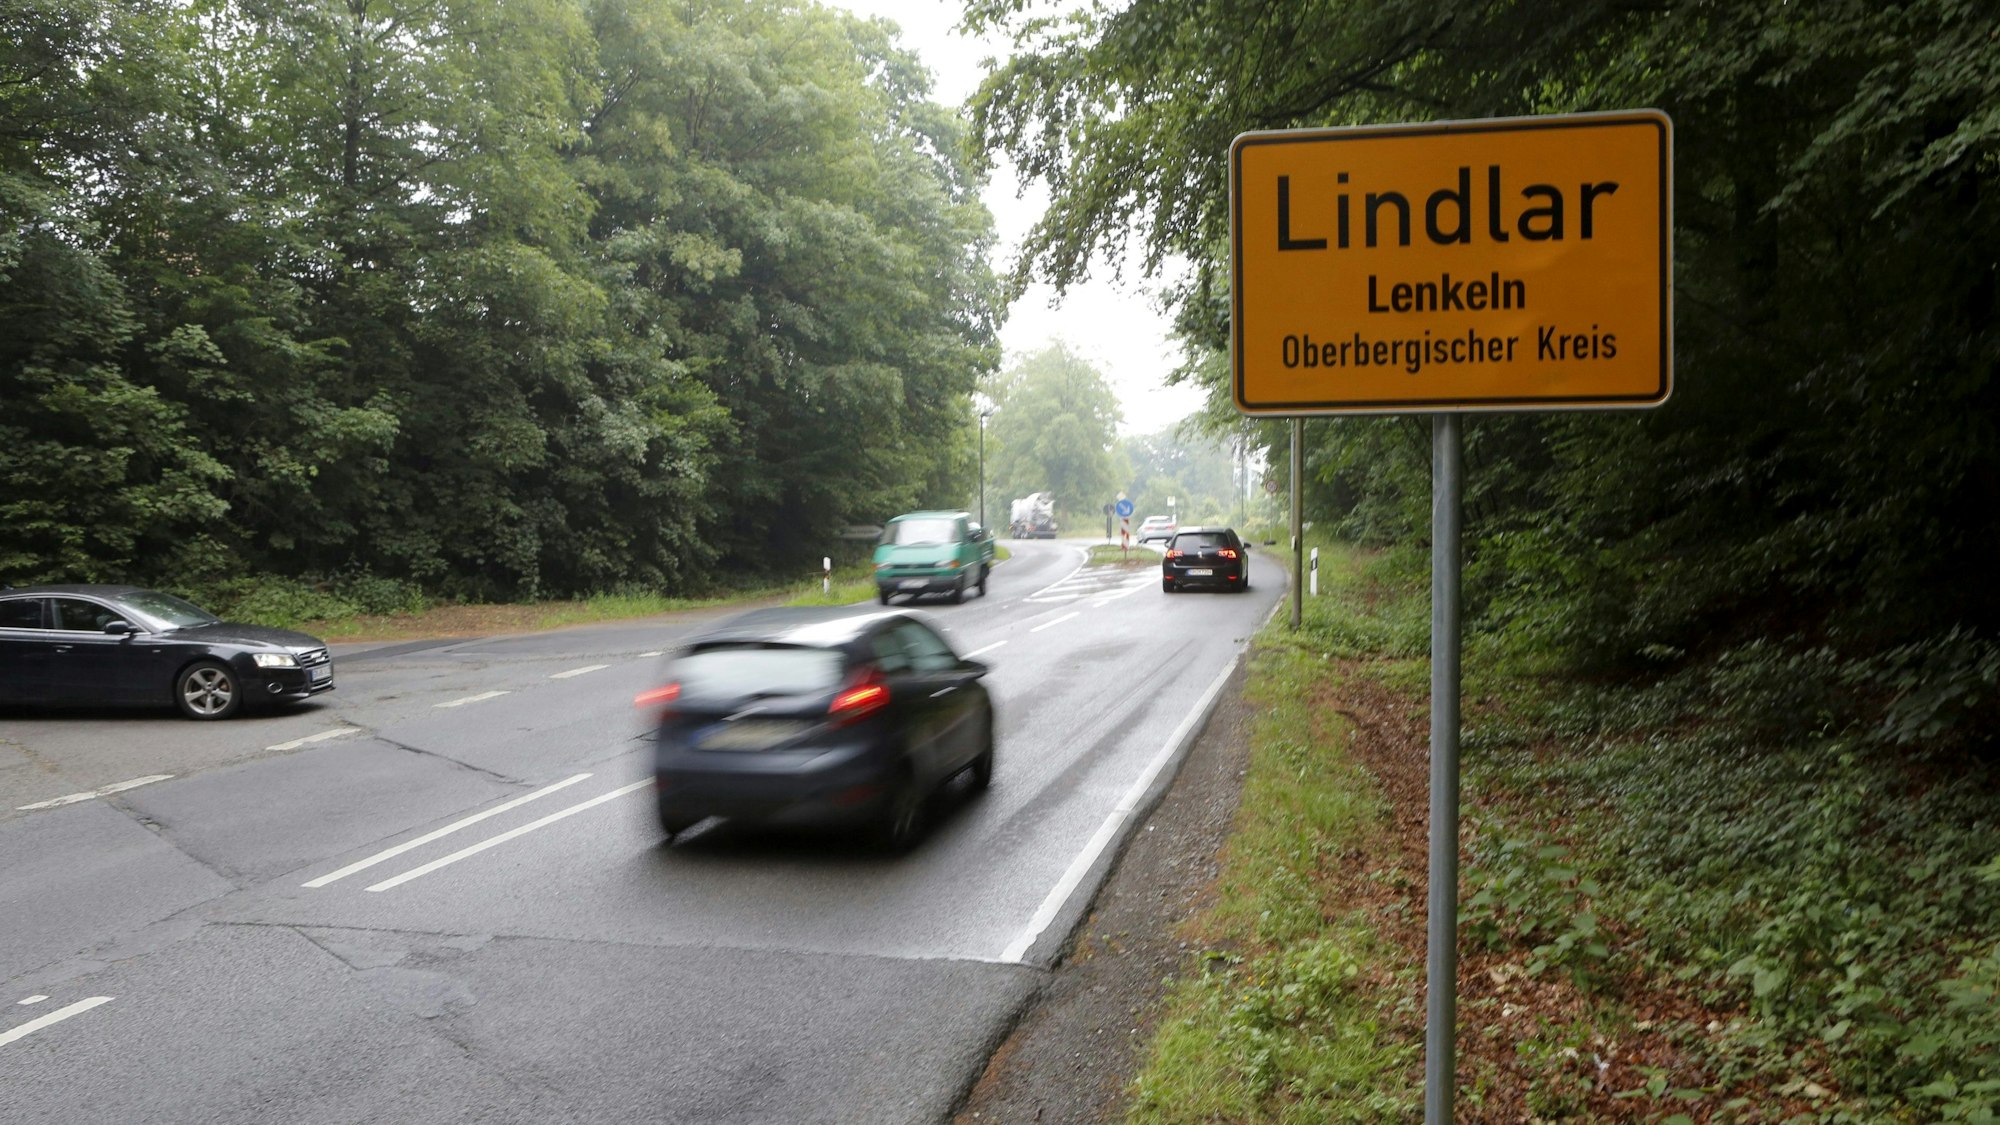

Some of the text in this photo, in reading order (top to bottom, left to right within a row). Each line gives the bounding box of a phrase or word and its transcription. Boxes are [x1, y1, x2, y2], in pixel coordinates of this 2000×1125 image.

[1277, 165, 1619, 251] Lindlar
[1368, 272, 1525, 313] Lenkeln
[1282, 325, 1617, 374] Oberbergischer Kreis
